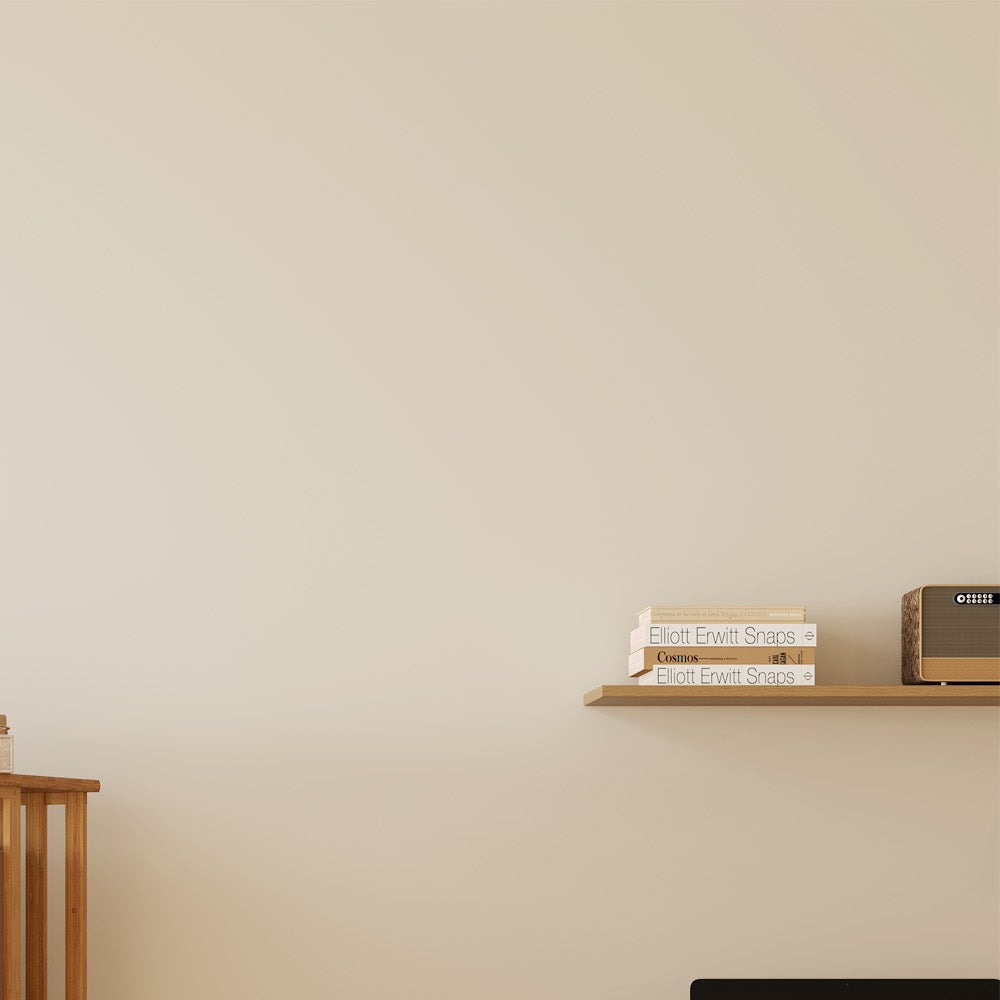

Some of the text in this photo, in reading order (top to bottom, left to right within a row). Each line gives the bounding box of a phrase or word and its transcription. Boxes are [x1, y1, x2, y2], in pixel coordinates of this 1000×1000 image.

[649, 626, 796, 646] Elliott Erwitt Snaps
[657, 650, 699, 663] Cosmos
[657, 667, 795, 686] Elliott Erwitt Snaps
